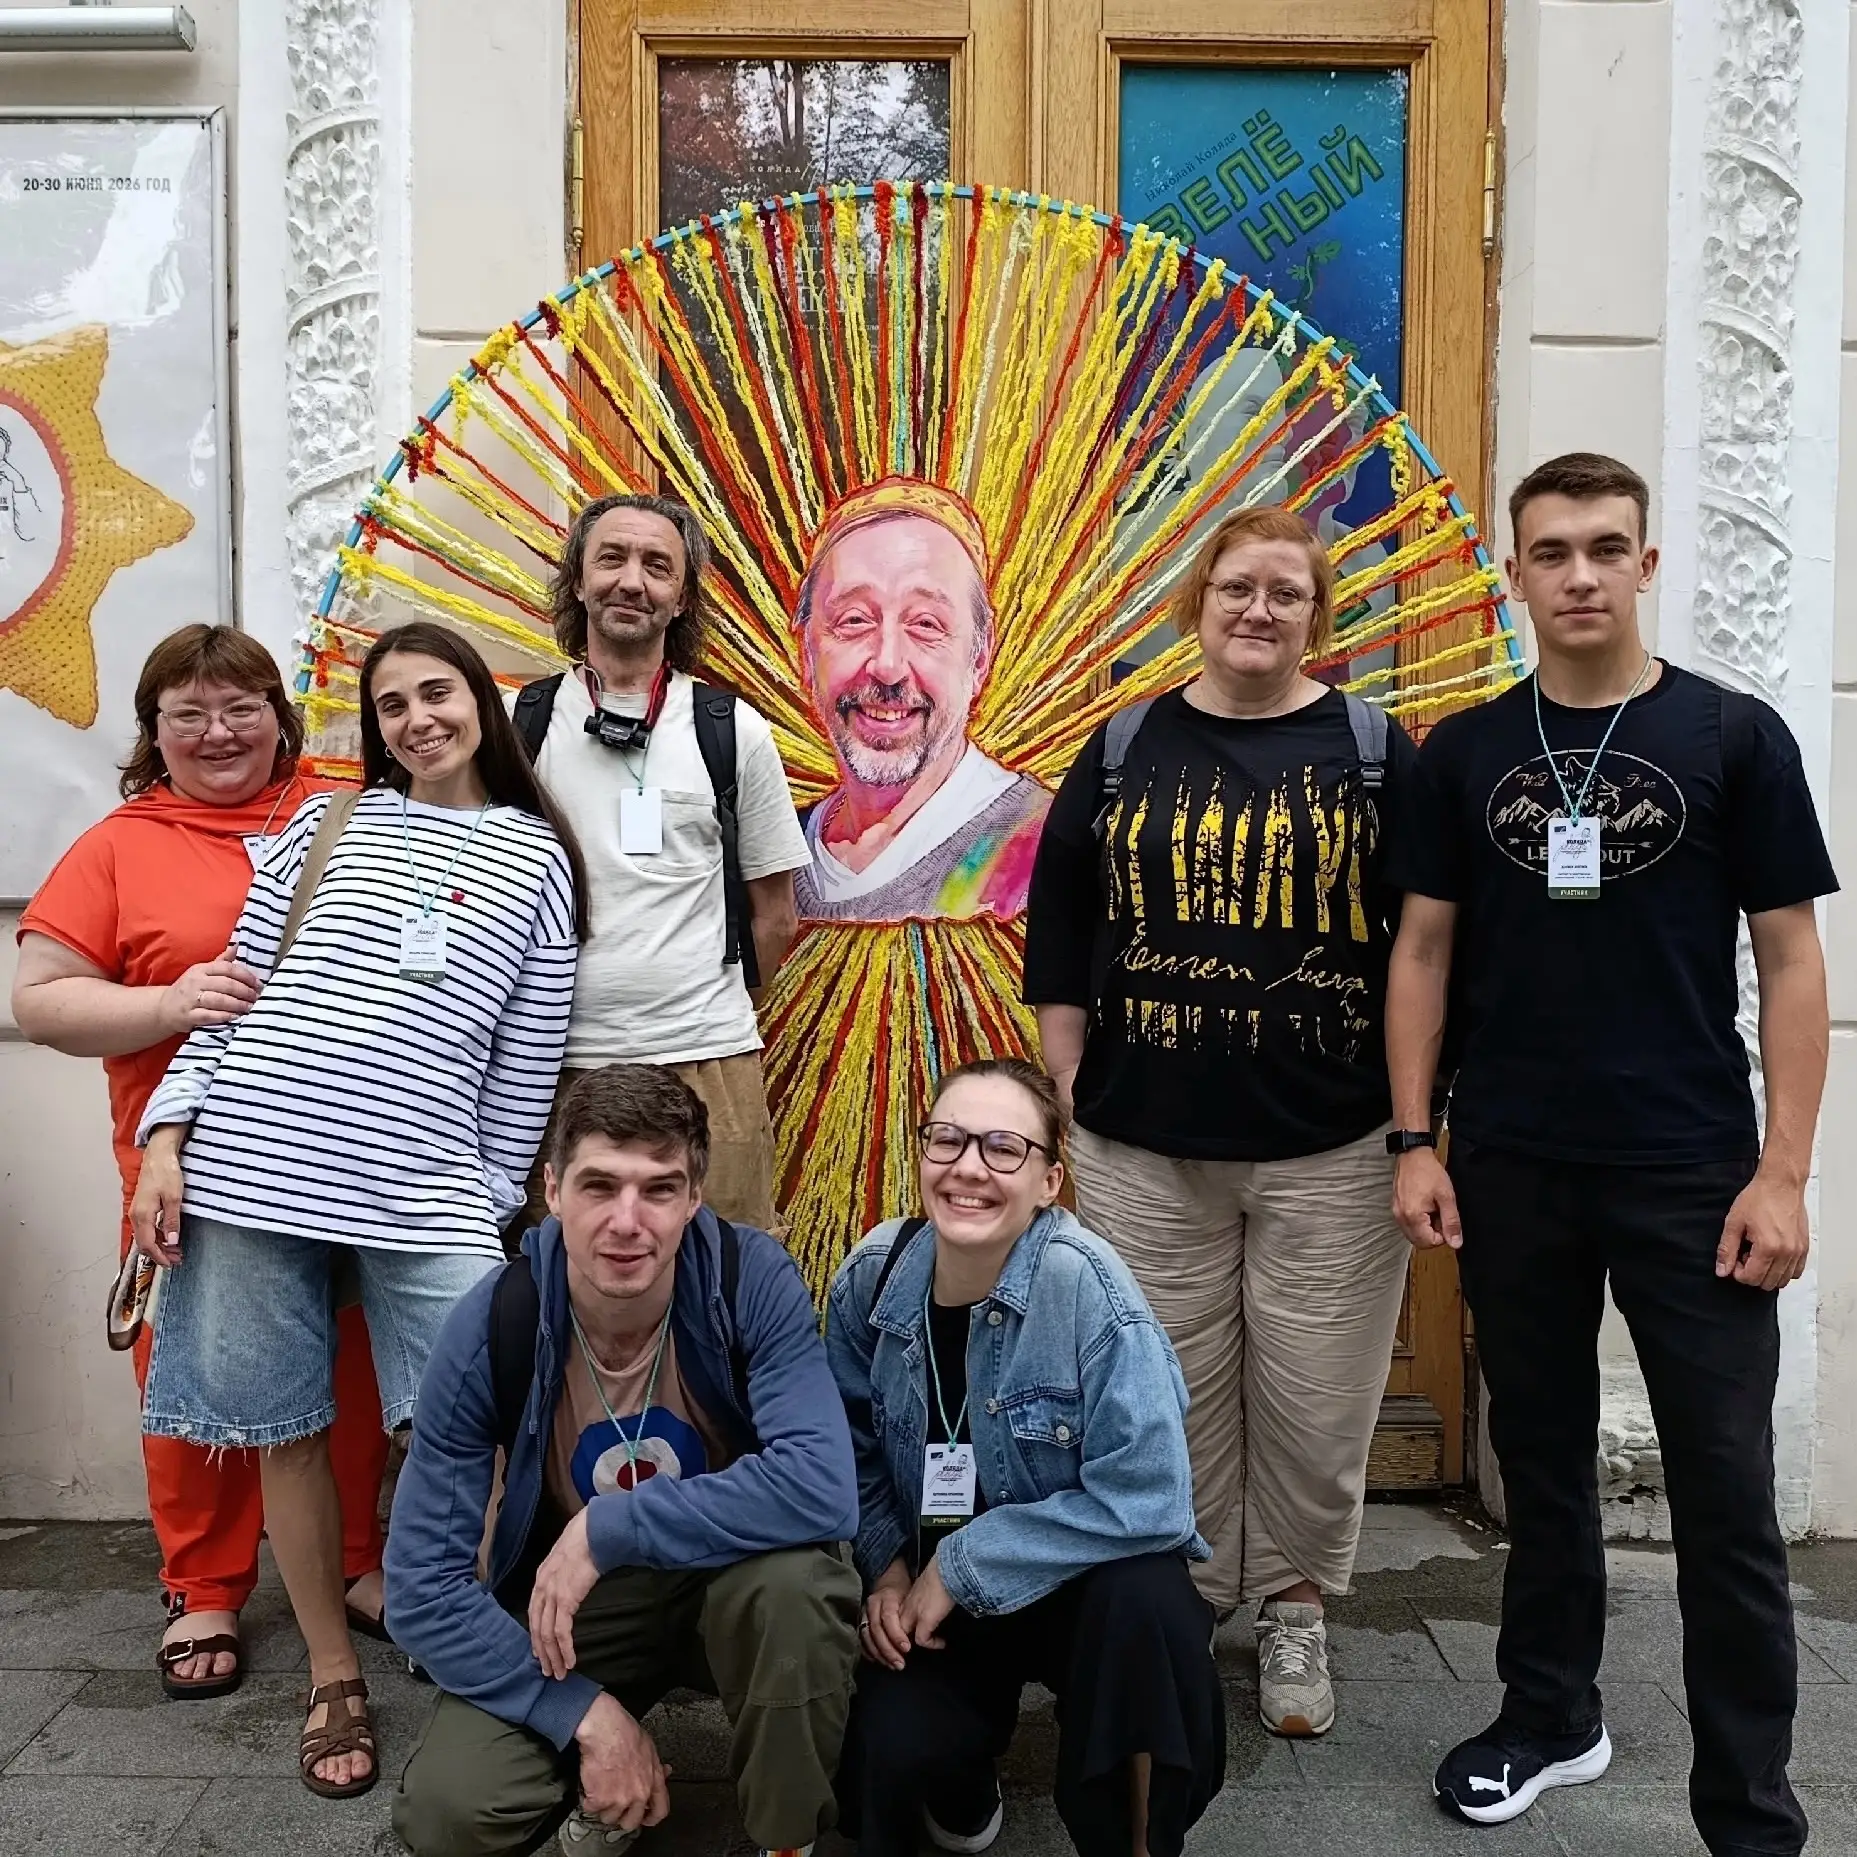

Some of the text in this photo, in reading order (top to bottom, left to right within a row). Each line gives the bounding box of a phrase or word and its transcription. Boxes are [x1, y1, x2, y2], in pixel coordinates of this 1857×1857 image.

[23, 178, 171, 193] 20-30 ИЮНЯ 2026 ГОД
[1144, 132, 1237, 202] Николай Коляда
[1144, 108, 1305, 246] ЗЕЛЁ
[1238, 124, 1385, 264] НЫЙ
